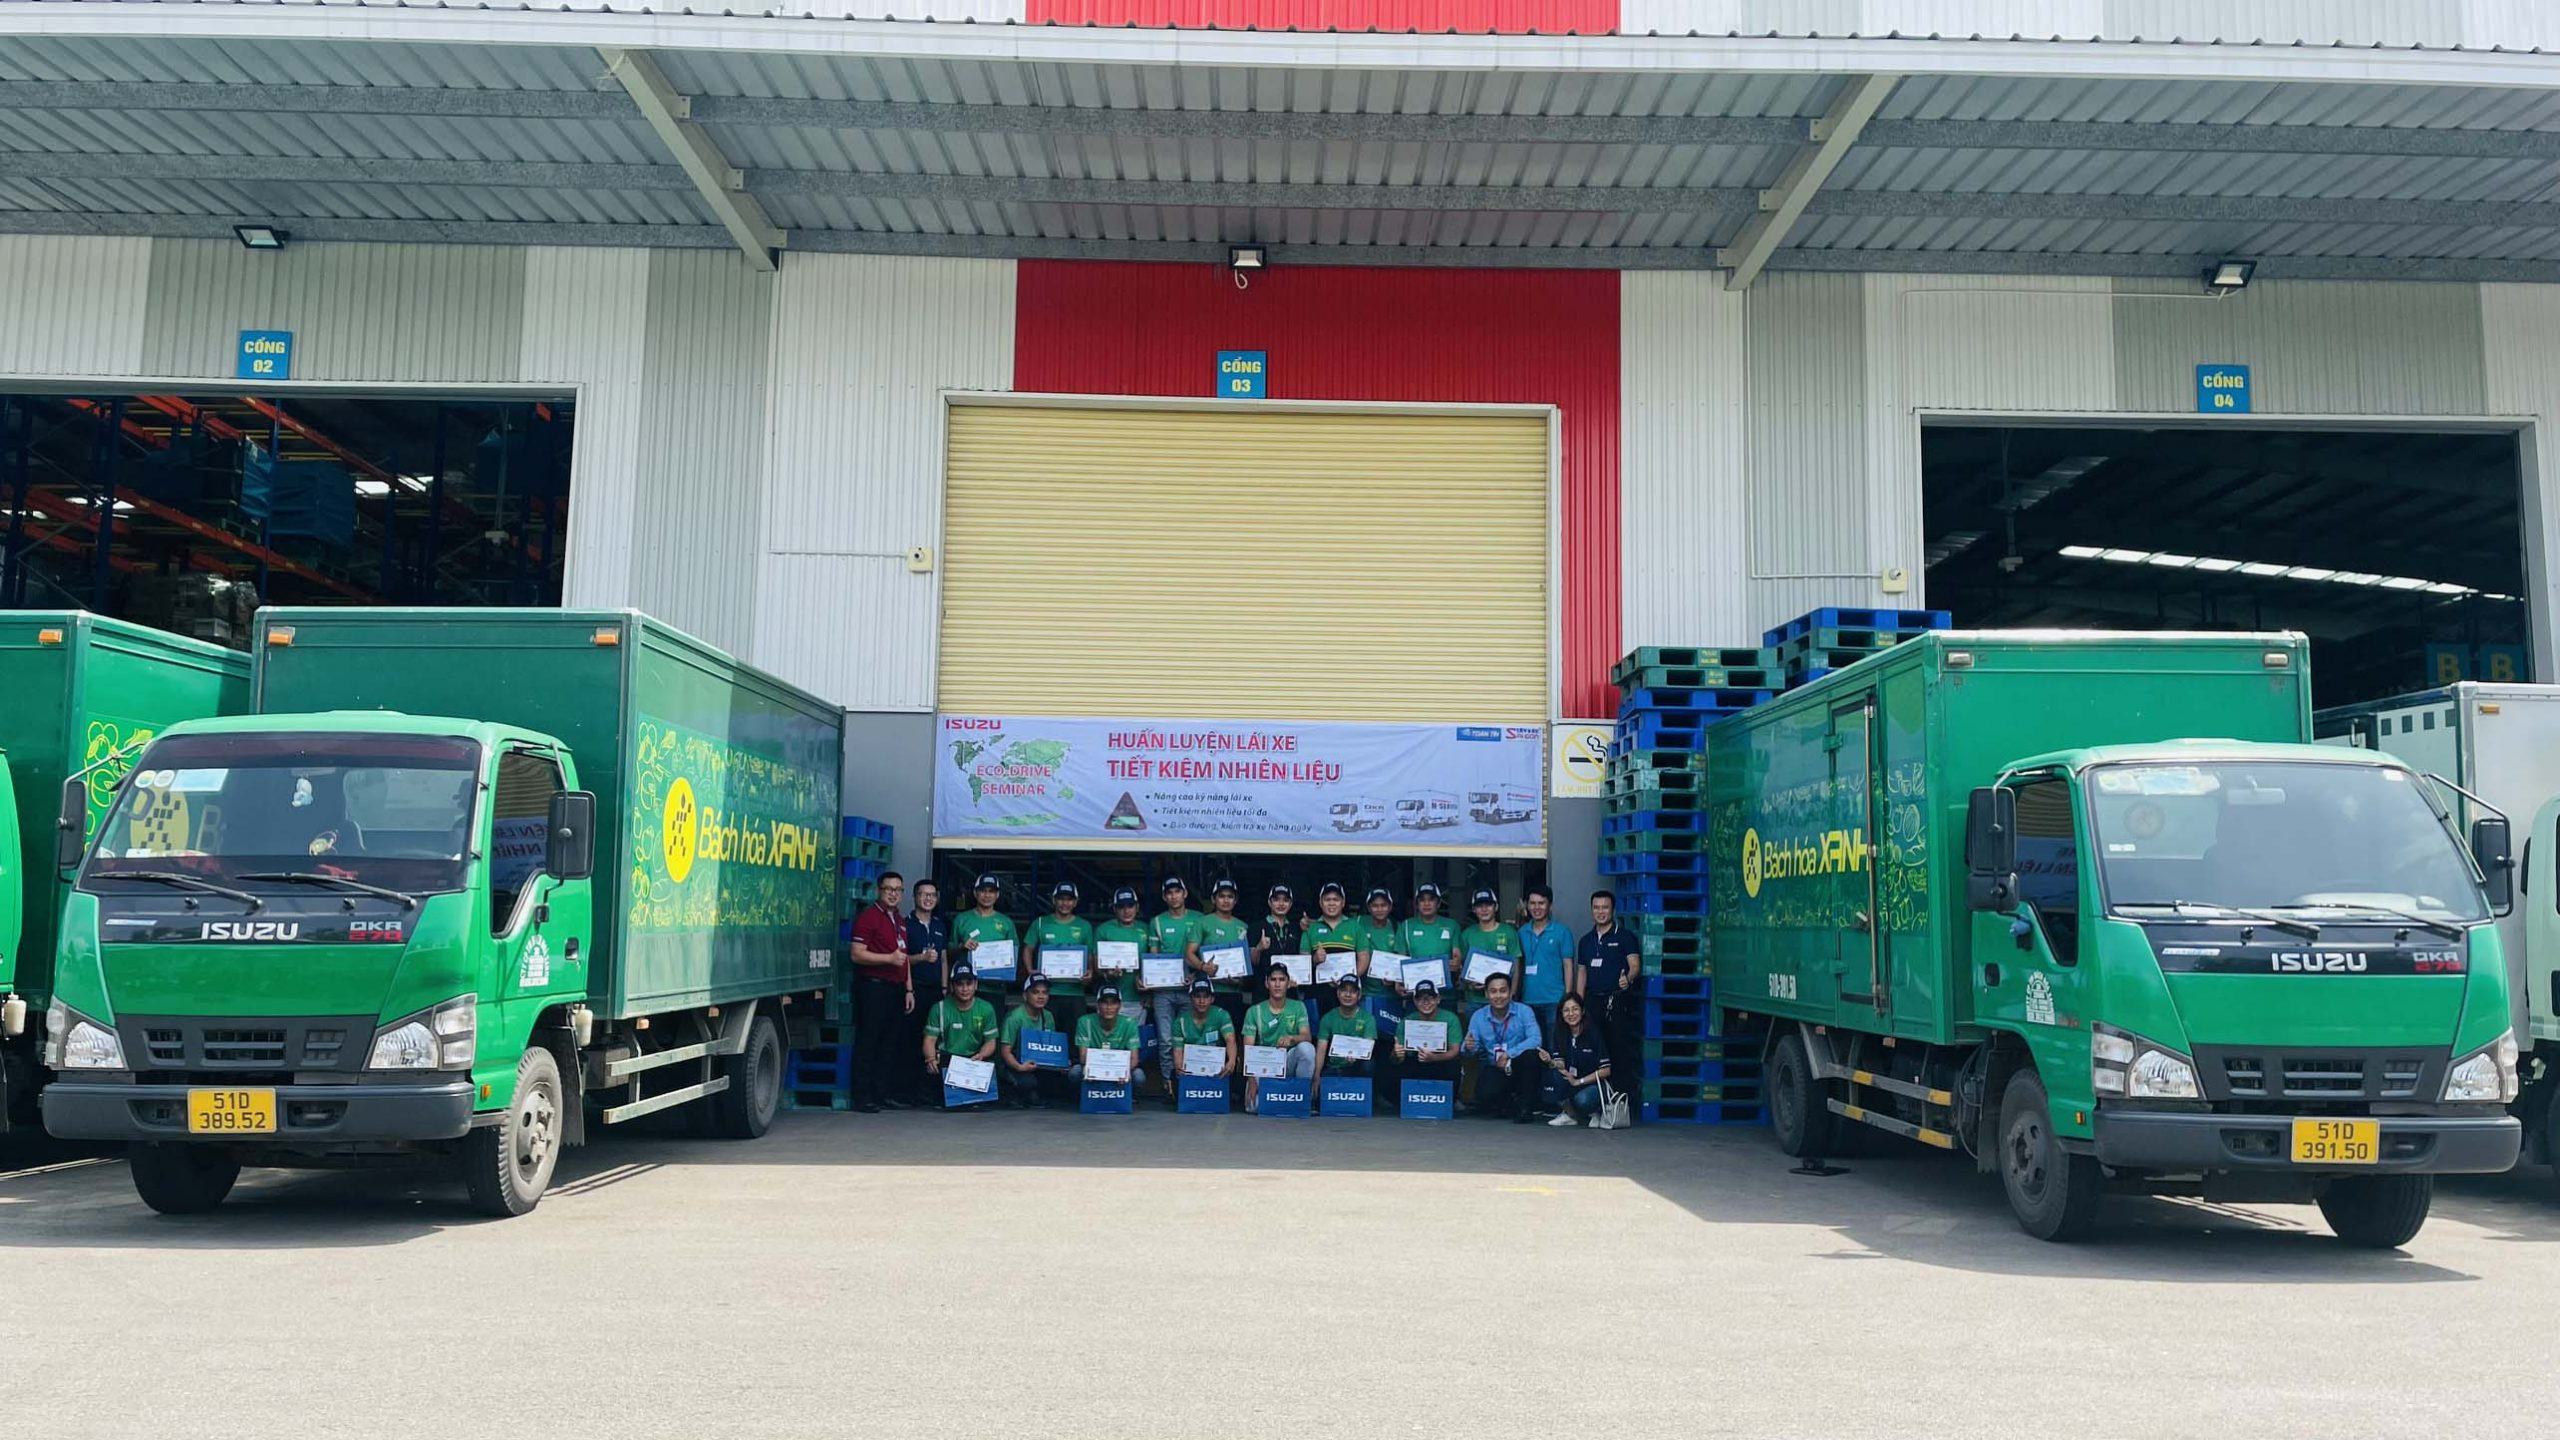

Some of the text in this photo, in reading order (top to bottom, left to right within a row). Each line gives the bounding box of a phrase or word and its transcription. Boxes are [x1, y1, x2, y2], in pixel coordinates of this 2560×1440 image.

[252, 359, 274, 373] 02
[1231, 379, 1251, 392] 03
[2213, 394, 2235, 407] 04
[945, 719, 1002, 730] ISUZU
[1108, 728, 1295, 754] HUẤN LUYỆN LÁI XE
[1107, 755, 1341, 785] TIẾT KIỆM NHIÊN LIỆU
[982, 783, 1046, 795] SEMINAR
[1256, 808, 1267, 816] đa
[698, 806, 818, 872] Bách hóa XANH
[1763, 827, 1869, 878] Bách hóa XANH
[201, 922, 299, 940] ISUZU
[350, 921, 402, 930] QKR
[349, 931, 402, 941] 270
[2271, 953, 2368, 972] ISUZU
[2412, 952, 2459, 962] QKR
[2414, 962, 2462, 972] 270
[1028, 1042, 1062, 1053] ISUZU
[213, 1092, 250, 1109] 51D
[1087, 1090, 1125, 1099] ISUZU
[1185, 1090, 1223, 1099] ISUZU
[1266, 1093, 1304, 1102] ISUZU
[1327, 1092, 1365, 1101] ISUZU
[1408, 1094, 1446, 1103] ISUZU
[199, 1112, 266, 1129] 389.52
[2318, 1123, 2354, 1139] 51D
[2302, 1142, 2368, 1159] 391.50
